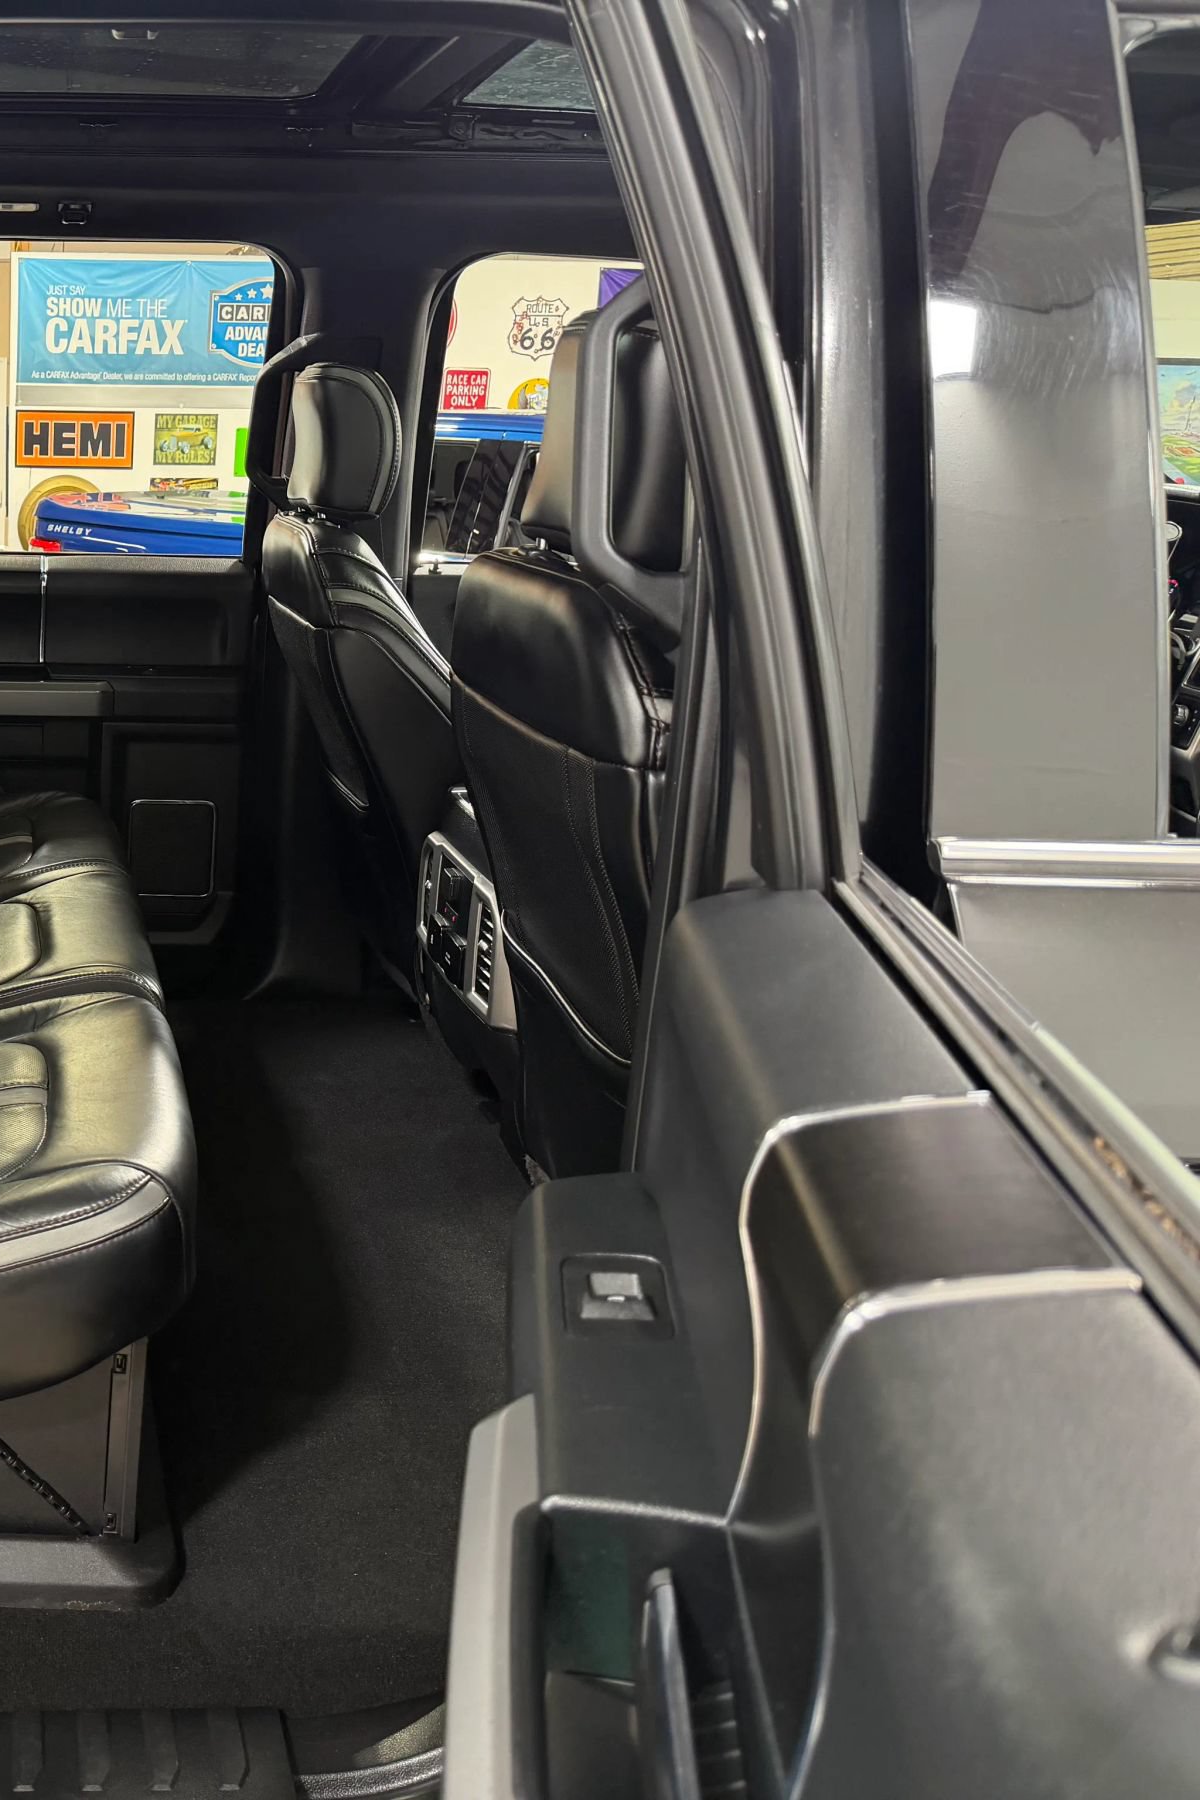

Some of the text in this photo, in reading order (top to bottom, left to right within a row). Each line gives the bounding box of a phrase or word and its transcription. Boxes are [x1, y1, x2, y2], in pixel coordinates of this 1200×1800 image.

[46, 285, 86, 295] JUST SAY
[46, 298, 168, 318] SHOW ME THE
[221, 306, 270, 320] CAR
[526, 303, 554, 314] ROUTE
[45, 319, 185, 355] CARFAX
[45, 371, 70, 379] CARFAX
[144, 373, 175, 381] committed
[183, 373, 206, 382] offering
[213, 373, 237, 381] CARFAX
[446, 374, 487, 385] RACE CAR
[446, 384, 485, 396] PARKING
[451, 396, 478, 406] ONLY
[157, 415, 216, 429] MY GARAGE
[24, 421, 126, 458] HEMI
[155, 450, 215, 464] MY RULES!
[47, 524, 92, 536] SHELBY
